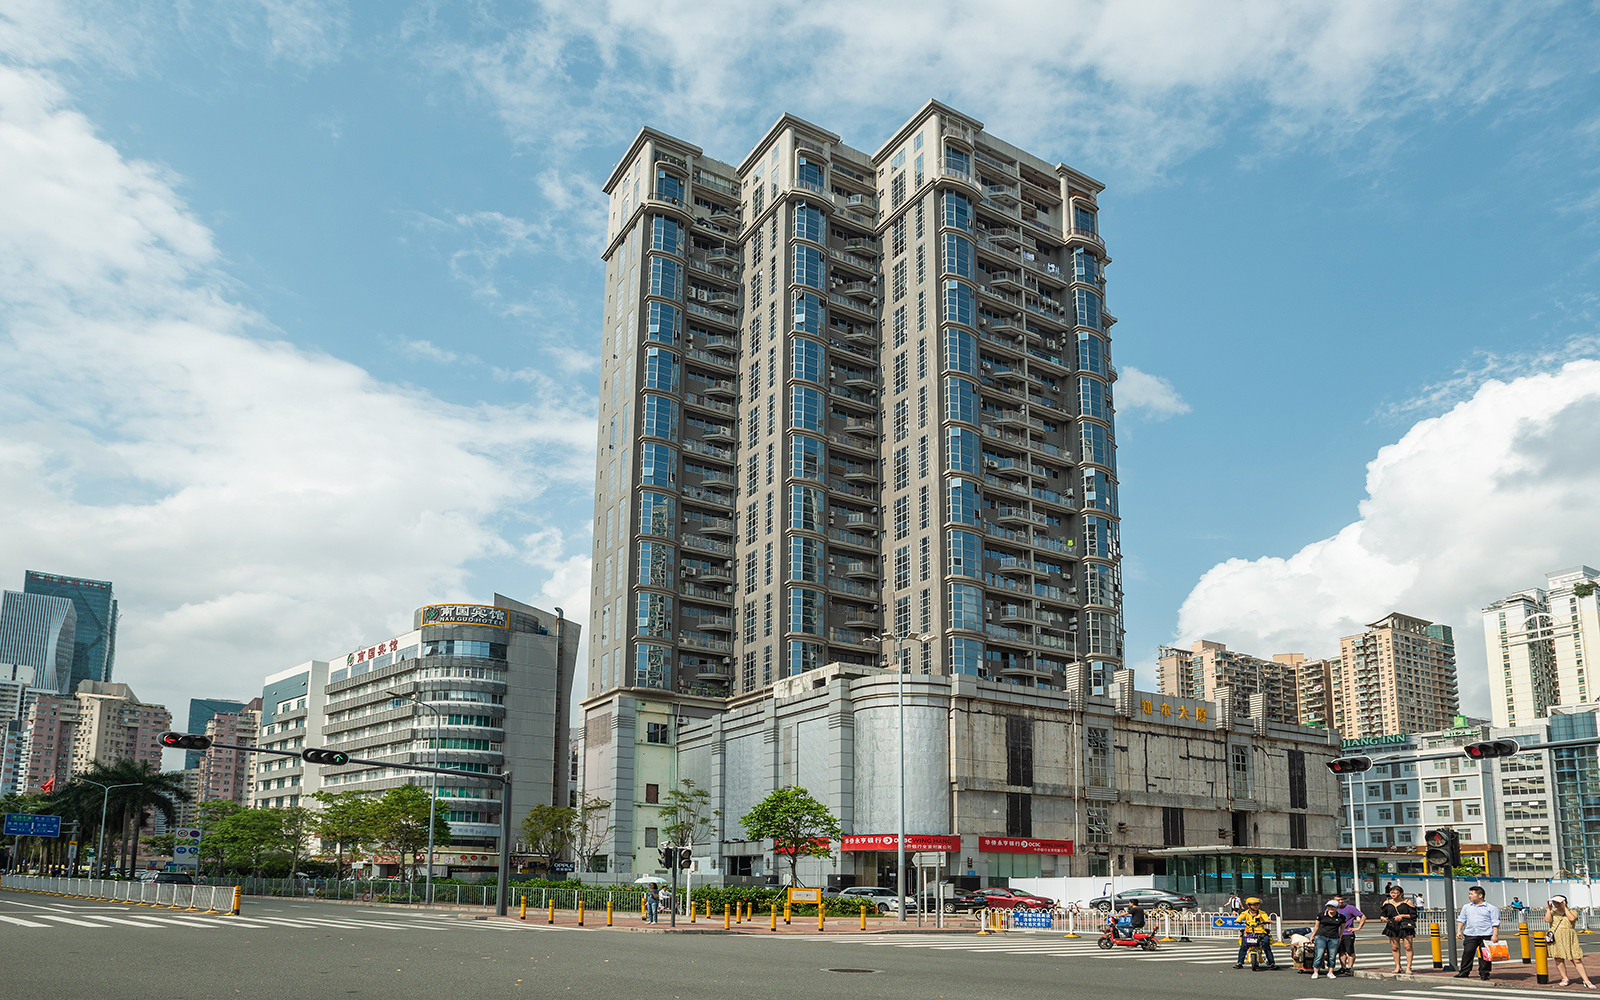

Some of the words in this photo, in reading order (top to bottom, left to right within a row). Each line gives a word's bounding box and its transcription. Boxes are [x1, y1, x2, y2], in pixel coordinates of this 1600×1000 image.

[440, 606, 505, 620] 南国宾馆
[475, 617, 503, 626] HOTEL
[357, 638, 398, 663] 南国宾馆
[1141, 699, 1207, 723] 知本大厦
[1342, 736, 1378, 748] JIANG
[1381, 733, 1406, 745] INN
[985, 839, 1020, 847] 华侨永亨银行
